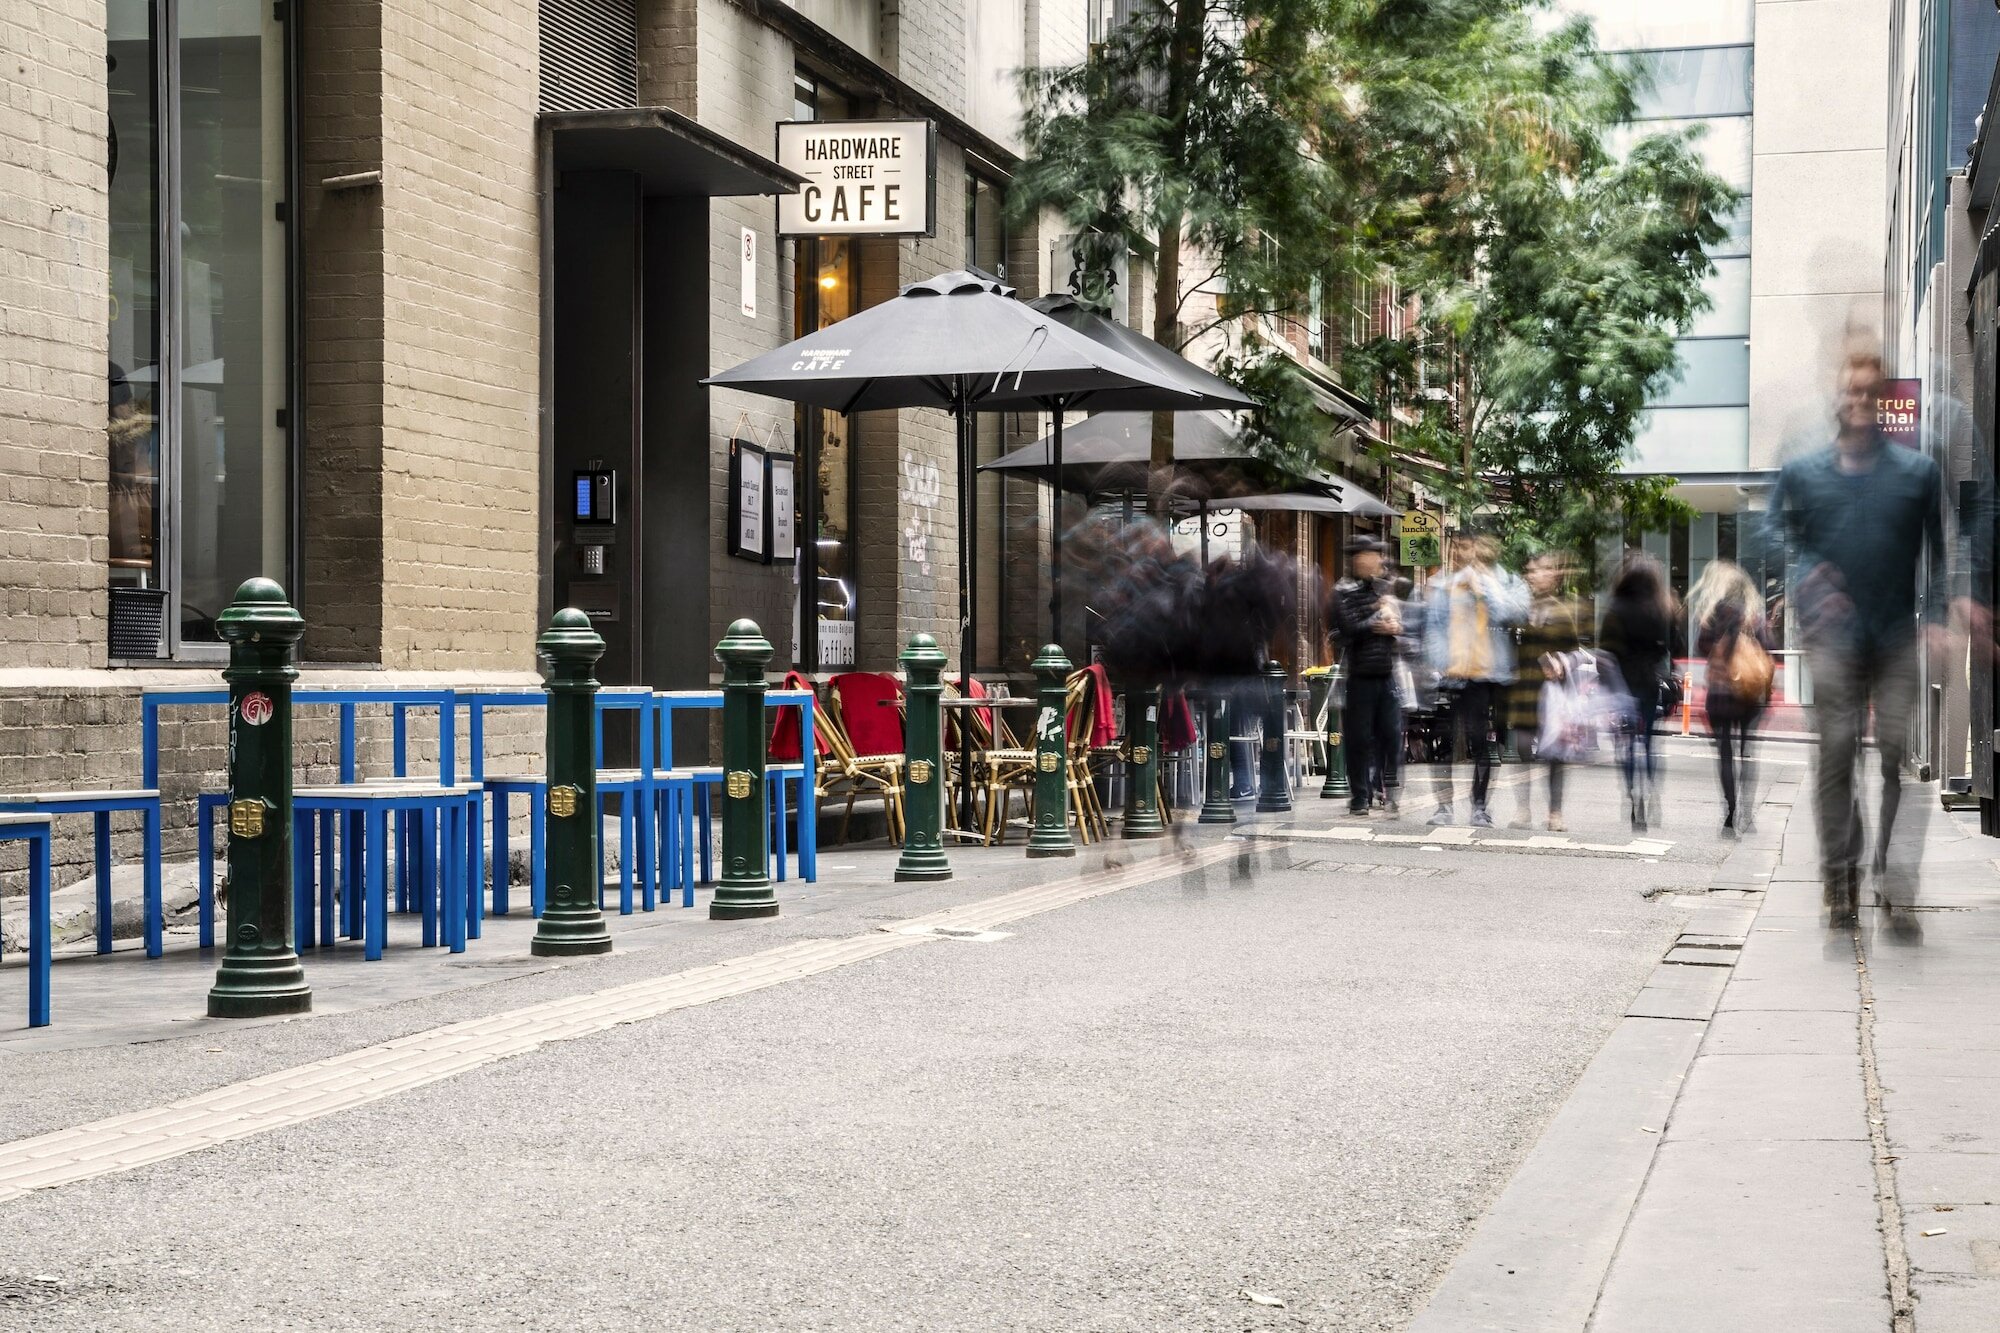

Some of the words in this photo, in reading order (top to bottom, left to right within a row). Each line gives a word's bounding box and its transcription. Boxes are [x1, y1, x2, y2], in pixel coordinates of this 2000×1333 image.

[805, 137, 901, 160] HARDWARE
[833, 165, 874, 180] STREET
[804, 184, 900, 222] CAFE
[997, 263, 1005, 279] 121
[800, 349, 852, 357] HARDWARE
[791, 360, 846, 371] CAFE
[1877, 398, 1915, 410] true
[1877, 412, 1914, 425] thai
[588, 459, 603, 472] 117
[839, 623, 854, 636] Belgian
